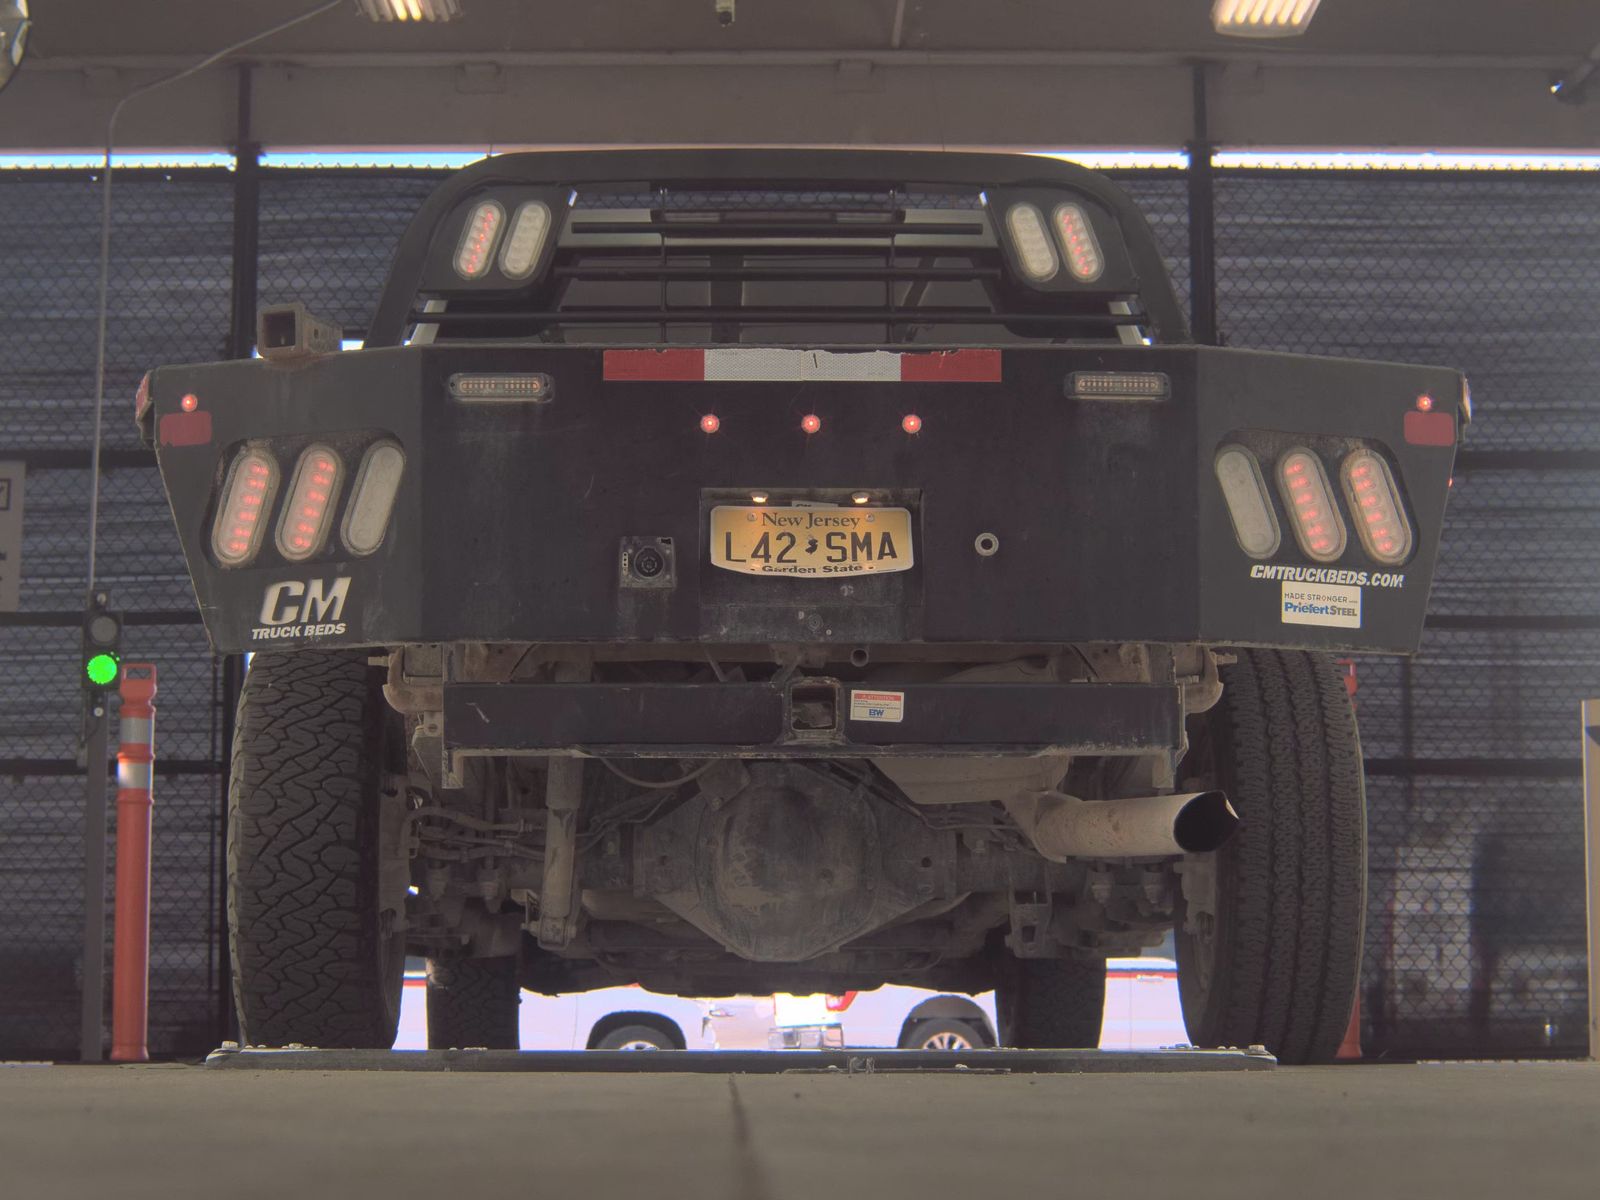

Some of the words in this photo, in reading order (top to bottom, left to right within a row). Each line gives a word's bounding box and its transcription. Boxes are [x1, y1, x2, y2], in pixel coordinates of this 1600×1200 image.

[762, 512, 803, 527] New
[806, 512, 861, 530] Jersey
[725, 531, 797, 563] L42
[826, 531, 898, 563] SMA
[762, 565, 816, 574] Garden
[823, 564, 863, 574] State
[1250, 565, 1405, 588] CMTRUCKBEDS.COM
[259, 576, 352, 625] CM
[1284, 593, 1306, 601] MADE
[1307, 593, 1348, 604] STRONGER
[251, 626, 302, 640] TRUCK
[304, 623, 347, 637] BEDS
